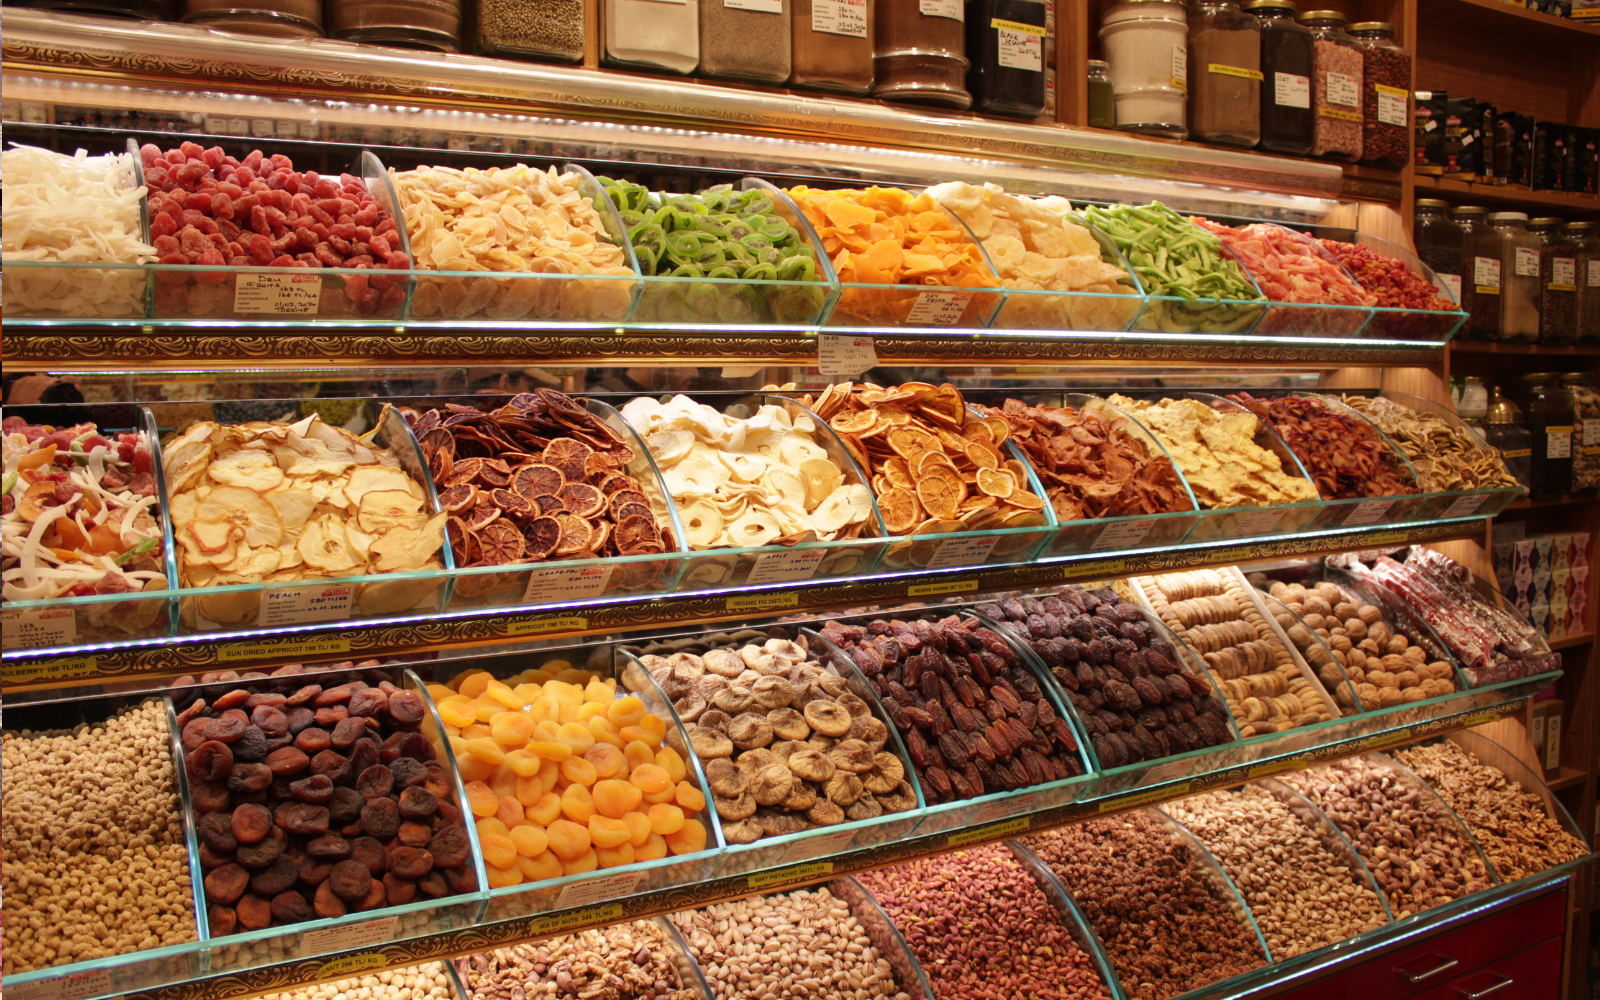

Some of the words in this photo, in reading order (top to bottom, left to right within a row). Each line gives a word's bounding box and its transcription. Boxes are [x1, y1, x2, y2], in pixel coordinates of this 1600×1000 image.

[1001, 30, 1018, 40] BLACK
[978, 827, 1002, 836] PISTACHIO
[770, 871, 797, 880] PISTACHIO
